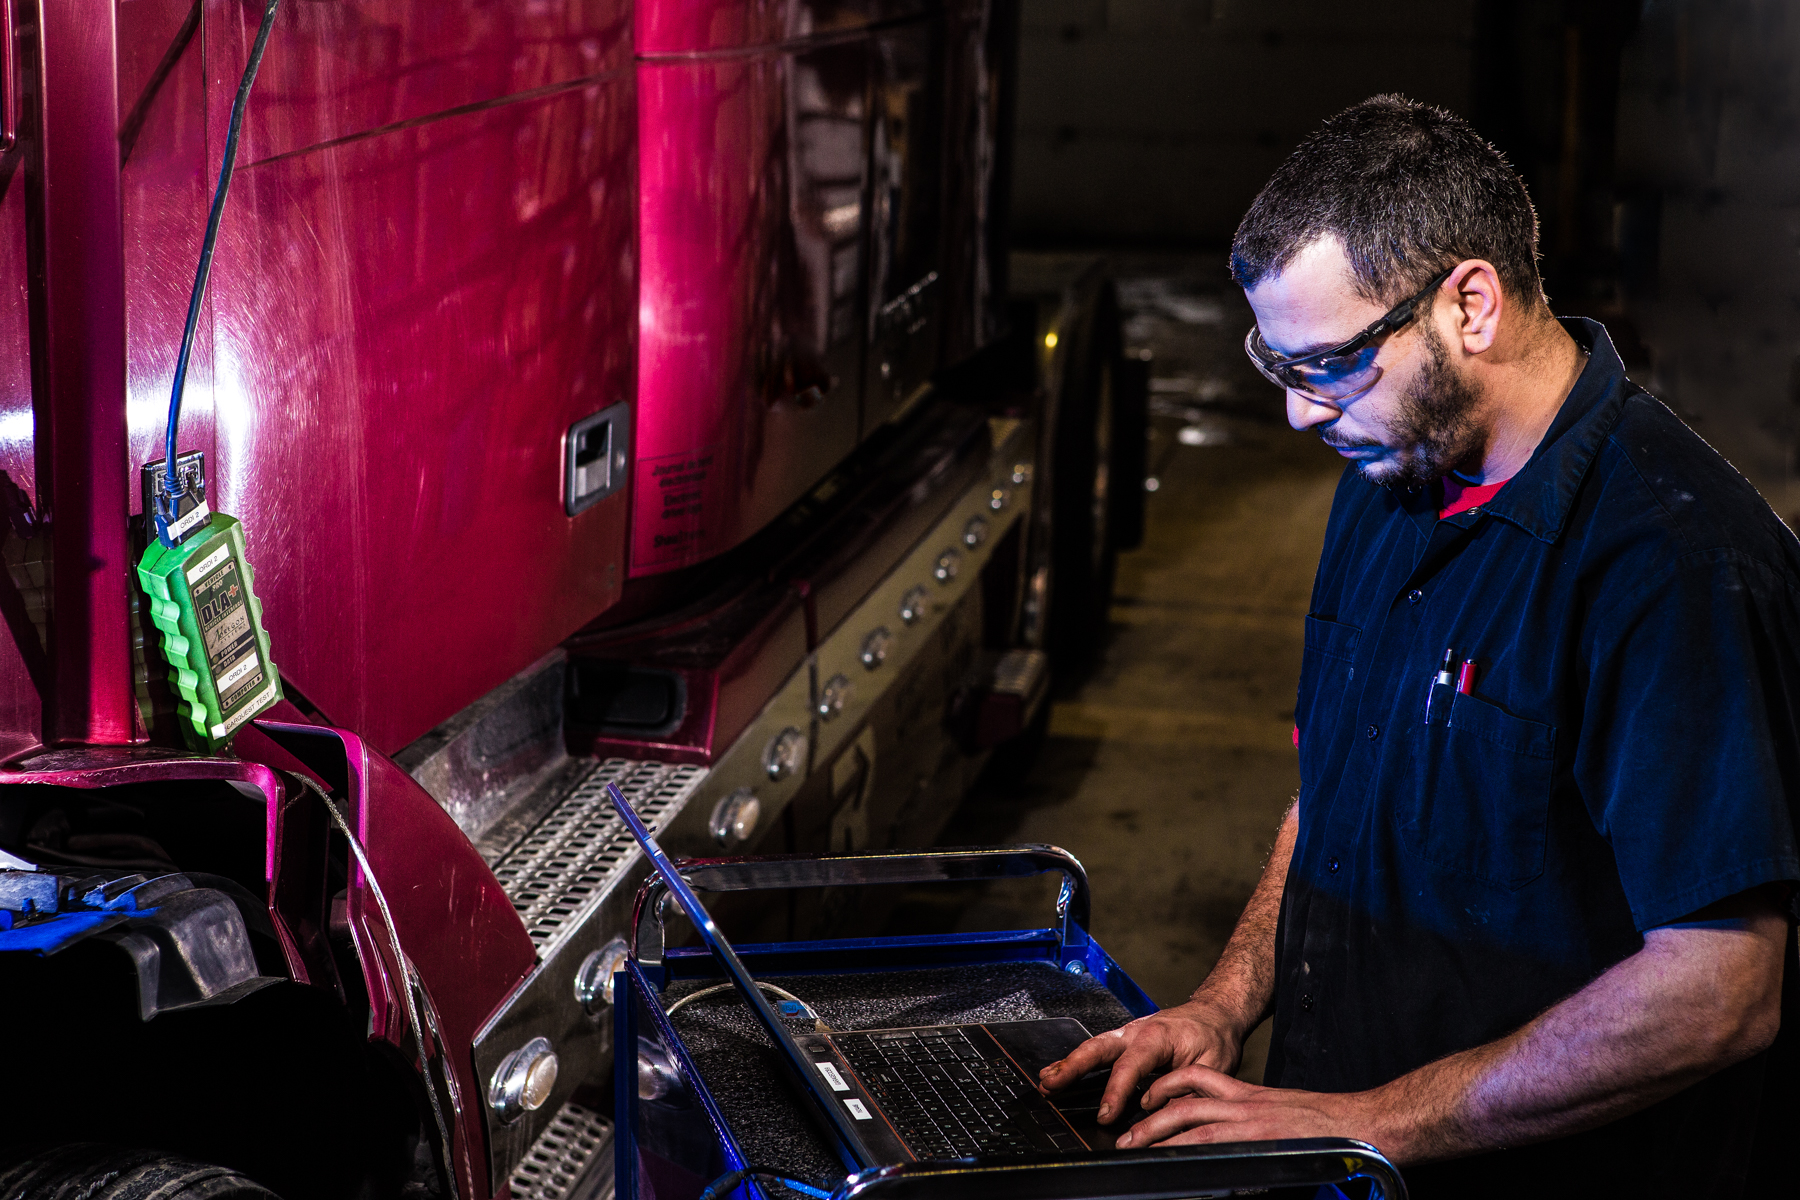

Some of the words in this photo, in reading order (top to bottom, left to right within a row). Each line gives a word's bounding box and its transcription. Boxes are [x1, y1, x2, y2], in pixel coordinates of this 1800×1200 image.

[180, 515, 195, 529] ORDI
[198, 559, 213, 573] ORDI
[205, 570, 224, 587] VEHICLE
[220, 641, 238, 657] POWER
[223, 654, 236, 667] DATA
[228, 668, 243, 681] ORDI
[230, 680, 256, 702] COMPUTER
[226, 704, 255, 730] CARQUEST
[256, 692, 270, 707] TEST
